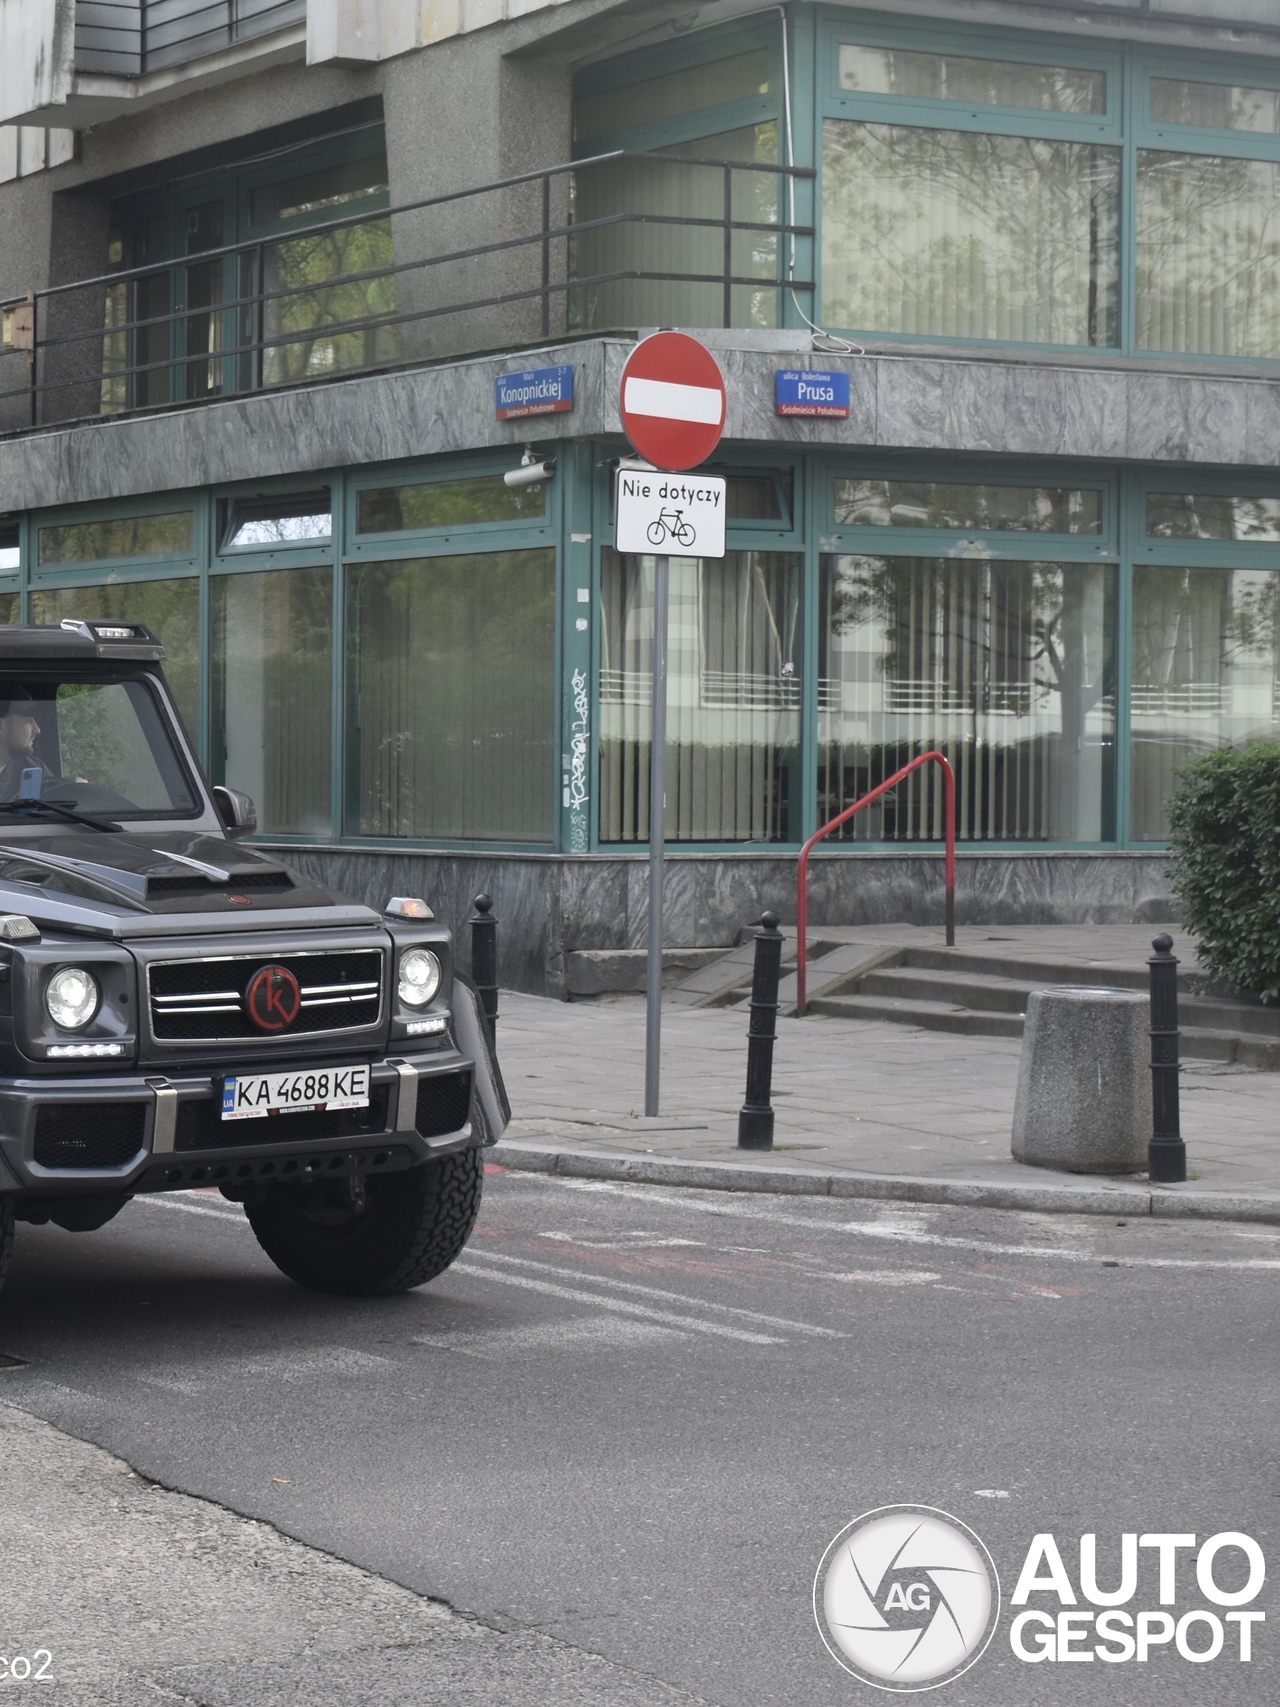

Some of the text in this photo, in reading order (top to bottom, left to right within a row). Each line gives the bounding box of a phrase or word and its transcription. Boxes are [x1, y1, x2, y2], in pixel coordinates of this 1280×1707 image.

[557, 367, 567, 375] 3-7
[783, 372, 831, 382] ulica Bolesława
[501, 378, 562, 405] Konopnickiej
[798, 382, 834, 401] Prusa
[782, 404, 847, 417] Śródmieście Południowe
[623, 479, 721, 508] Nie dotyczy
[237, 1070, 366, 1107] KA 4688 KE
[223, 1099, 234, 1108] UA
